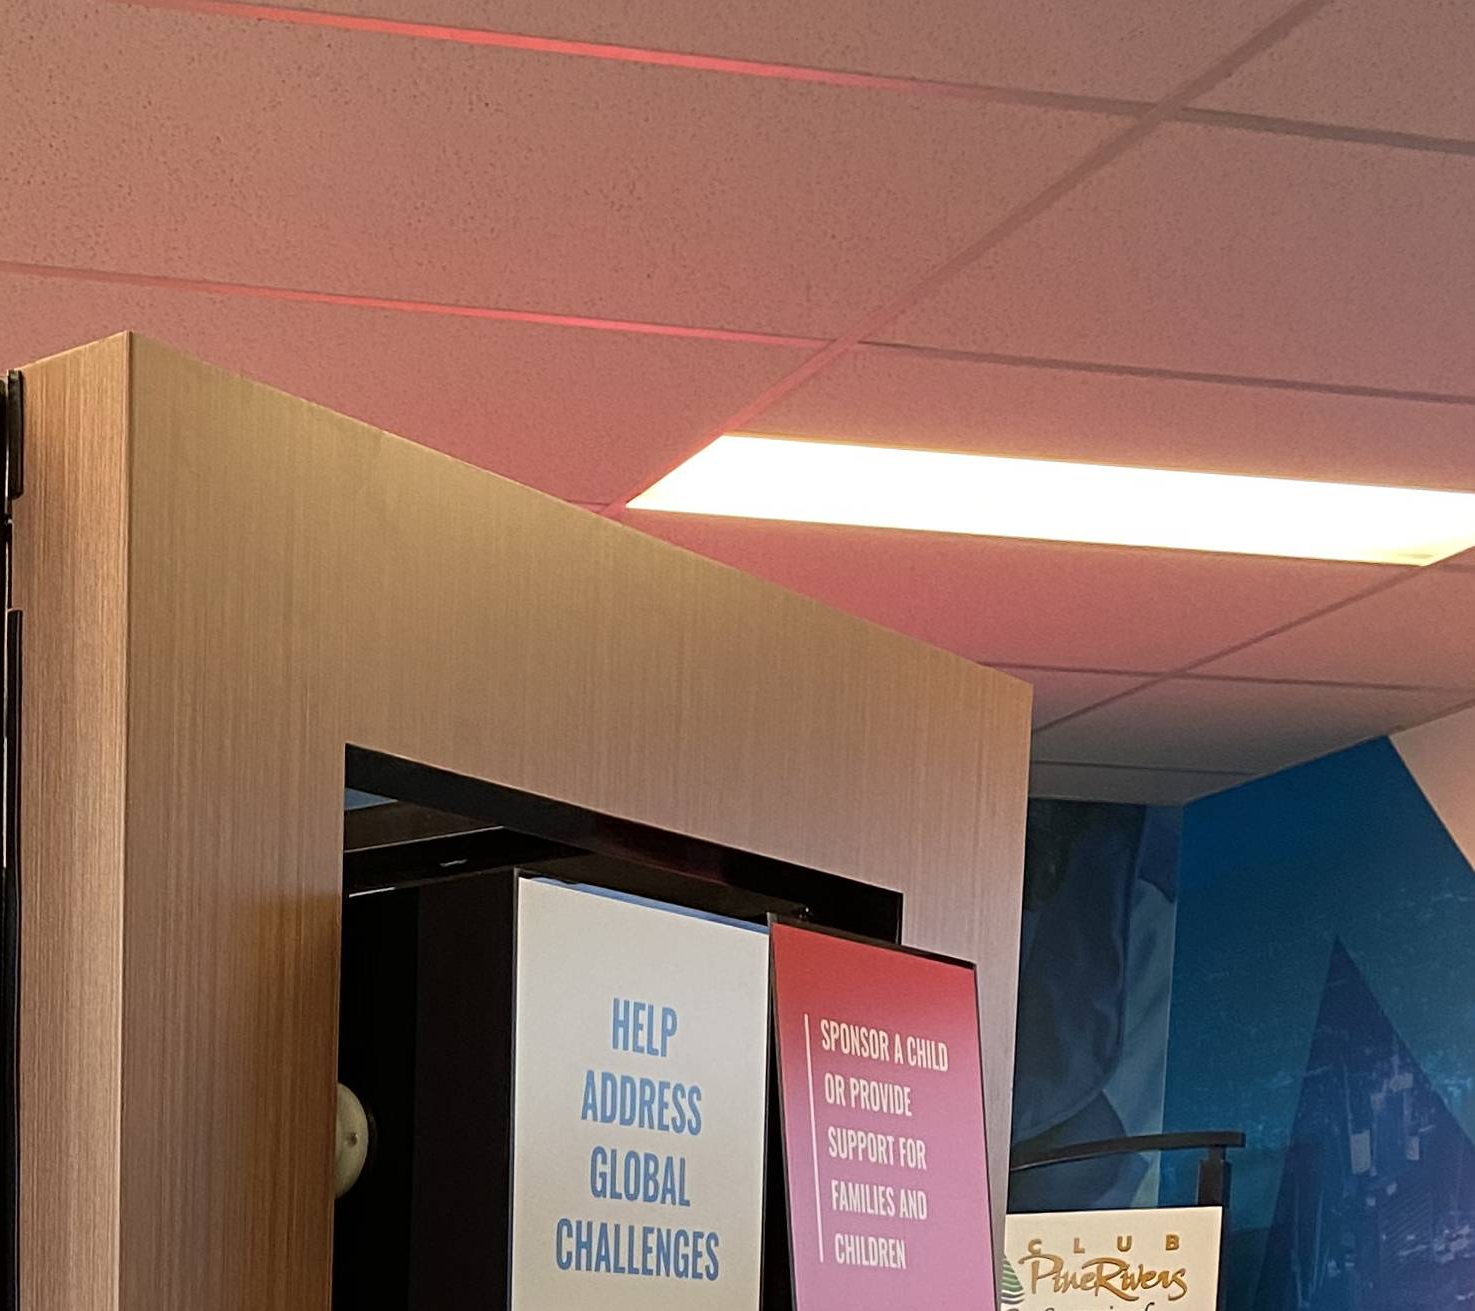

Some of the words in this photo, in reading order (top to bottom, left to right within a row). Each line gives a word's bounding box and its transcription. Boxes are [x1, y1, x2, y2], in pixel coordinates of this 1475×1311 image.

[612, 998, 678, 1058] HELP
[820, 1019, 890, 1062] SPONSOR
[893, 1033, 904, 1065] A
[906, 1036, 948, 1072] CHILD
[581, 1070, 702, 1136] ADDRESS
[824, 1072, 846, 1107] OR
[849, 1077, 912, 1117] PROVIDE
[828, 1126, 894, 1166] SUPPORT
[899, 1137, 927, 1170] FOR
[590, 1146, 691, 1207] GLOBAL
[831, 1179, 896, 1217] FAMILIES
[899, 1188, 928, 1220] AND
[556, 1218, 720, 1282] CHALLENGES
[834, 1233, 906, 1270] CHILDREN
[1027, 1234, 1180, 1255] CLUB
